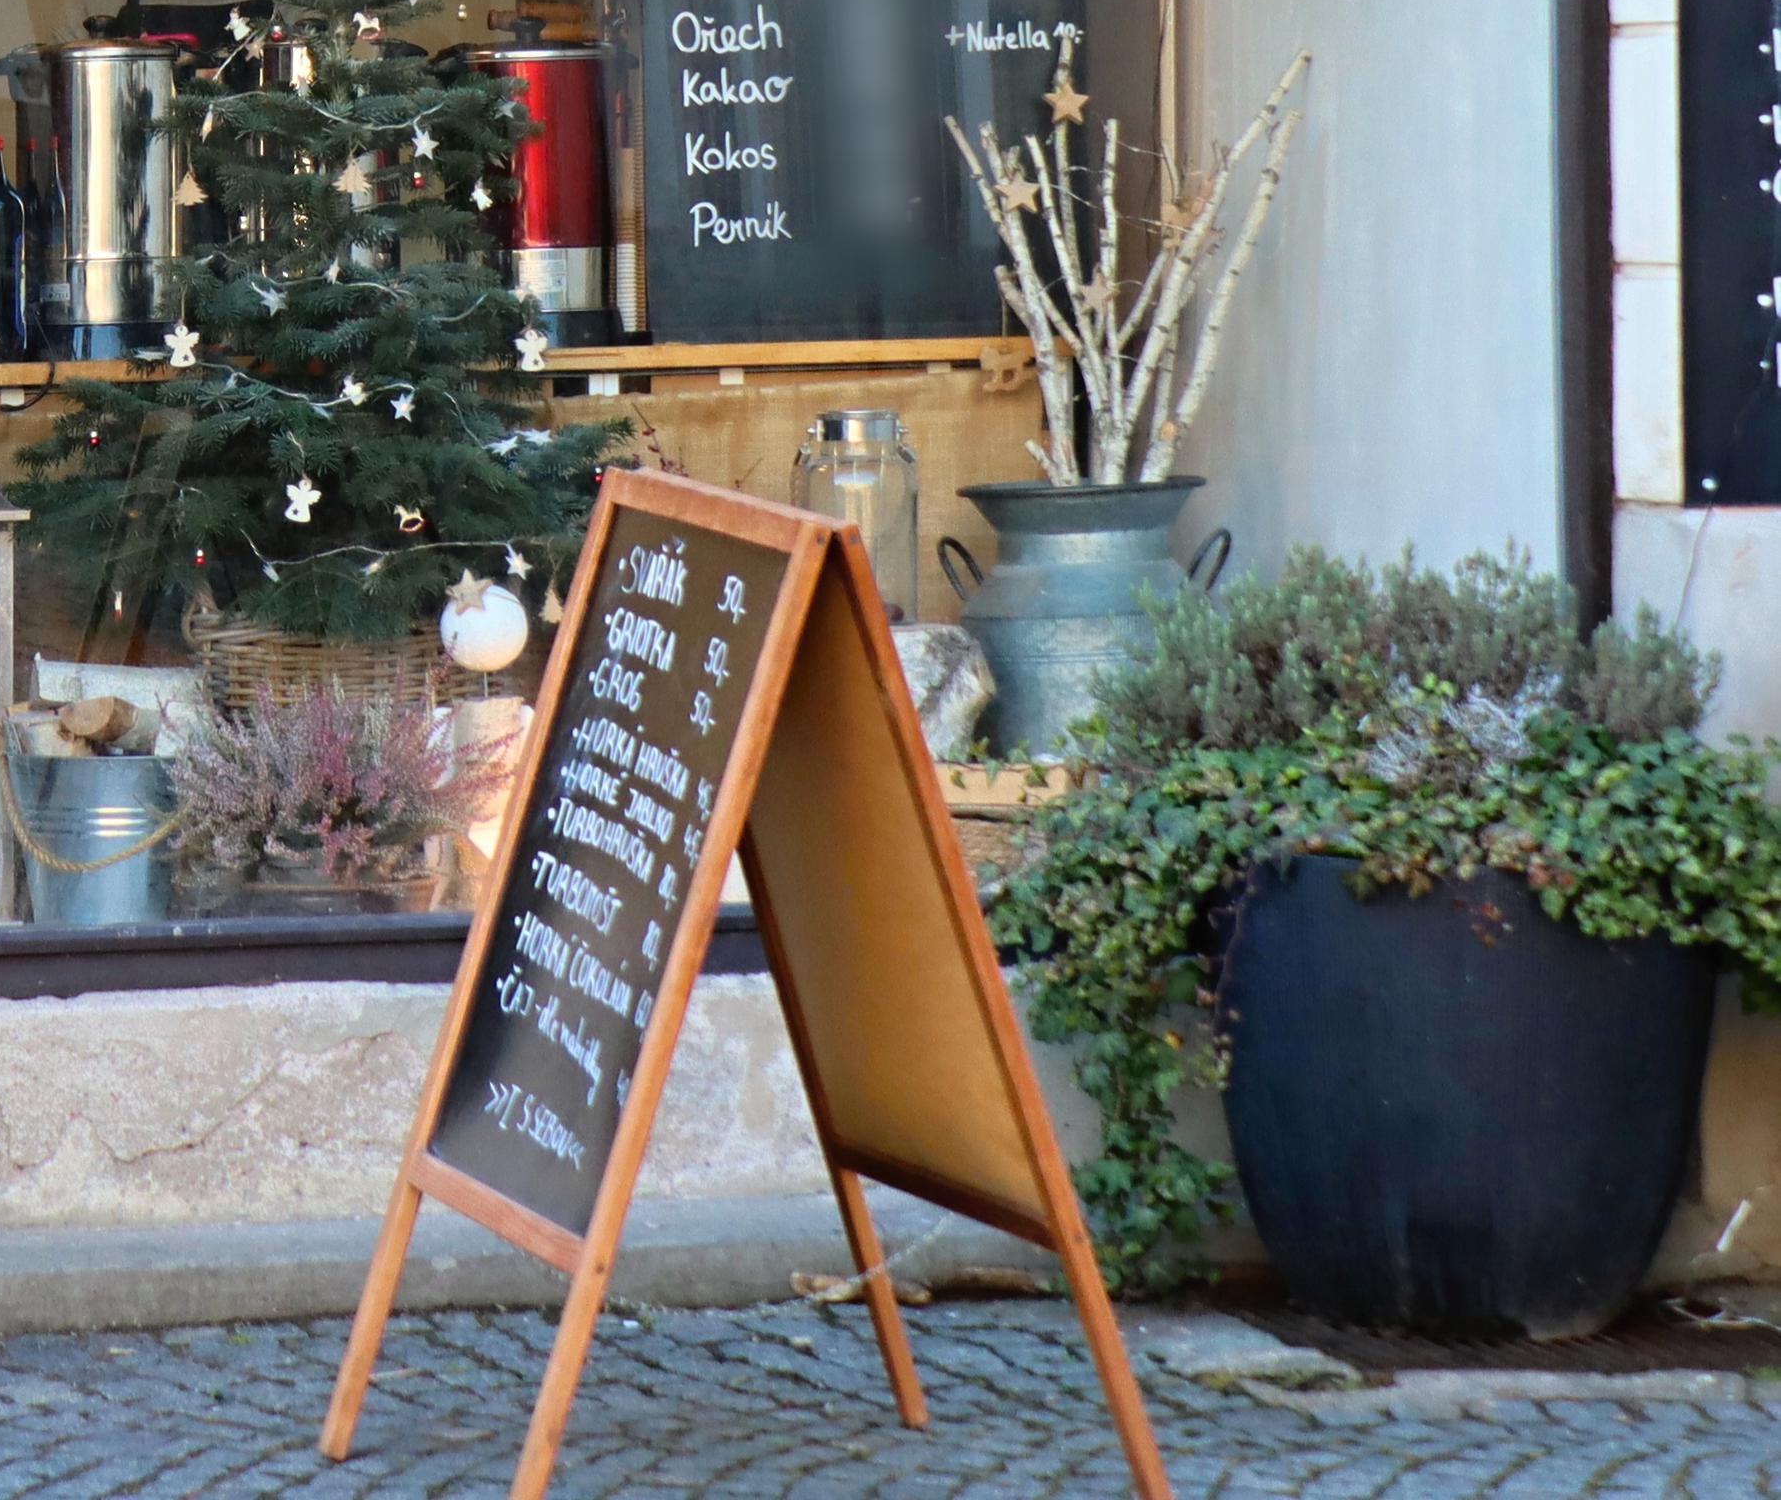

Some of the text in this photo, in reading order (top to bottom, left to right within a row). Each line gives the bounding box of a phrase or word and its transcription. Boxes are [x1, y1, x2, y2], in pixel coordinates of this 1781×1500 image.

[671, 3, 783, 54] Ořech
[682, 67, 793, 108] Kakao
[685, 131, 777, 176] Kokos
[608, 607, 676, 672] GRIOTKA
[593, 657, 644, 712] GROG
[634, 741, 690, 800] HRUŠKA
[624, 788, 675, 843] JABLKO
[500, 964, 535, 1016] ČAJ
